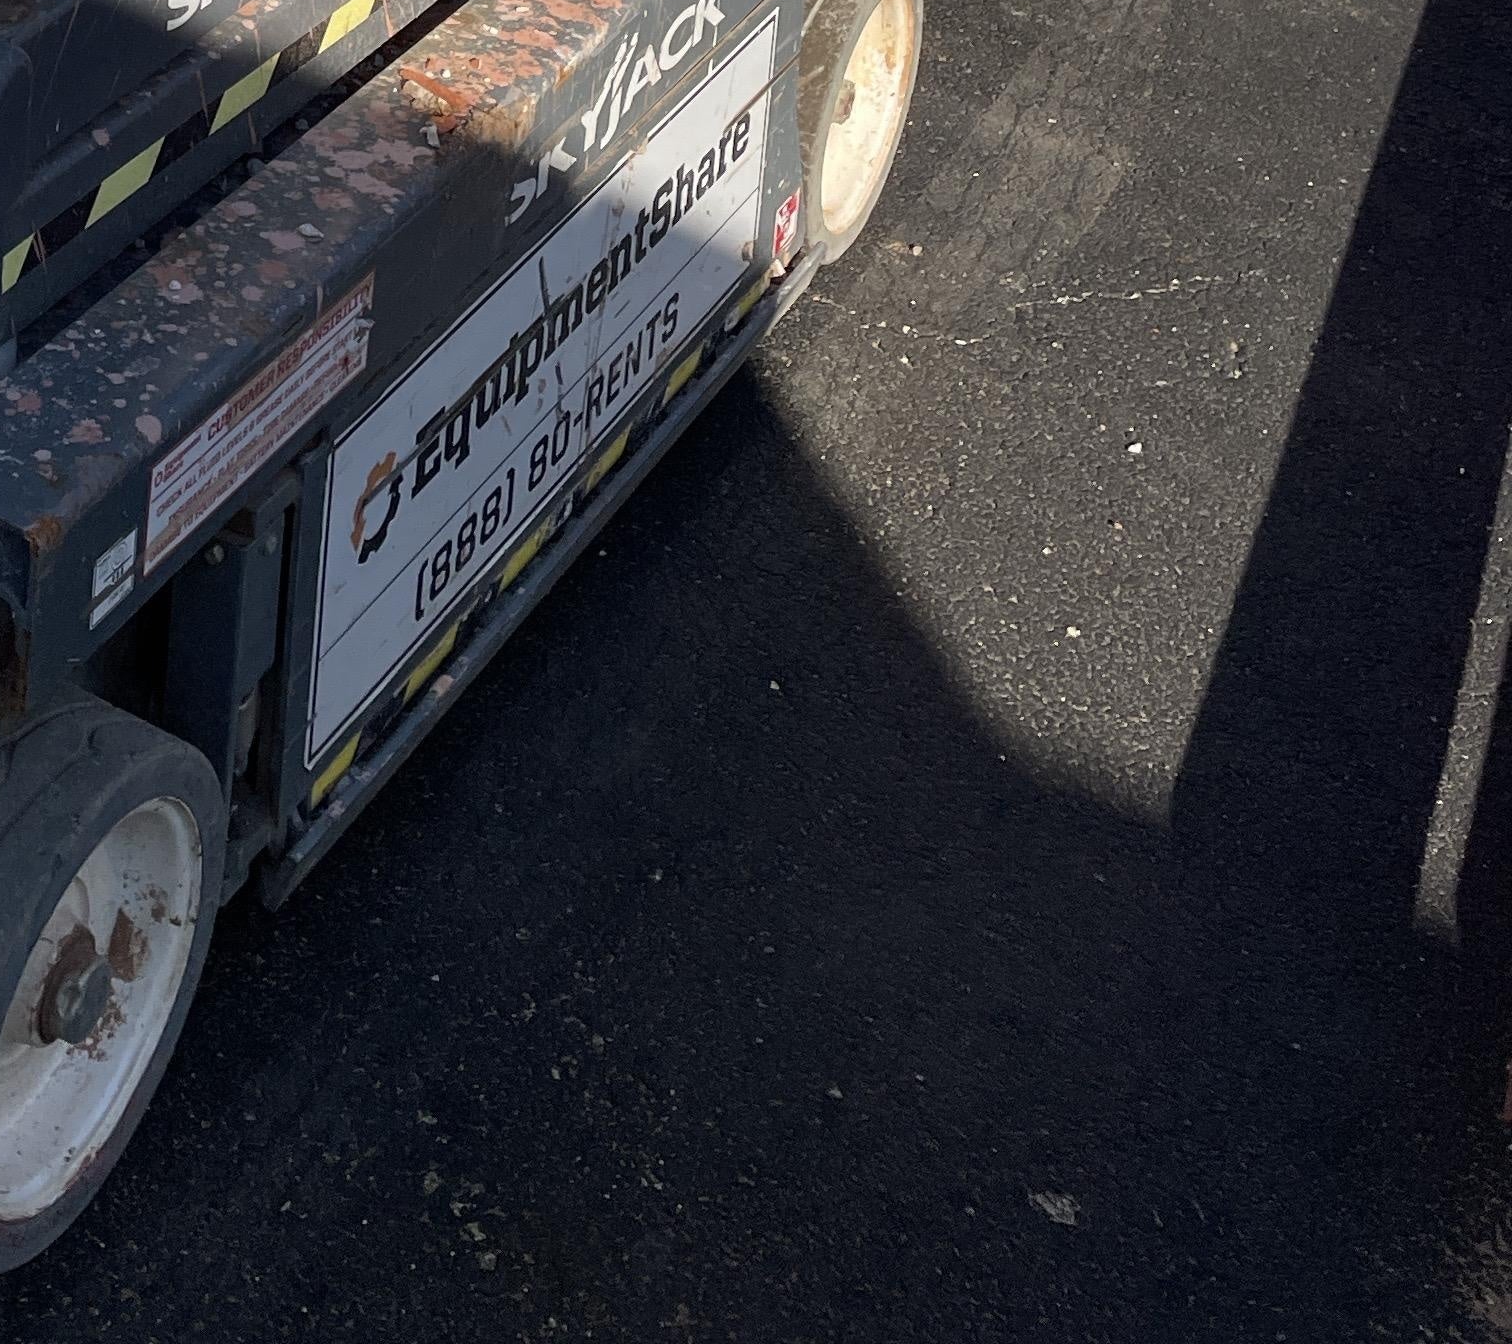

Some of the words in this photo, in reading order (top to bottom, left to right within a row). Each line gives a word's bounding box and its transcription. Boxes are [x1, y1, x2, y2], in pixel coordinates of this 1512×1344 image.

[207, 367, 276, 442] CUSTOMER
[411, 110, 752, 500] EquipmentShare
[414, 466, 516, 622] (888)
[527, 291, 680, 493] 80-RENTS
